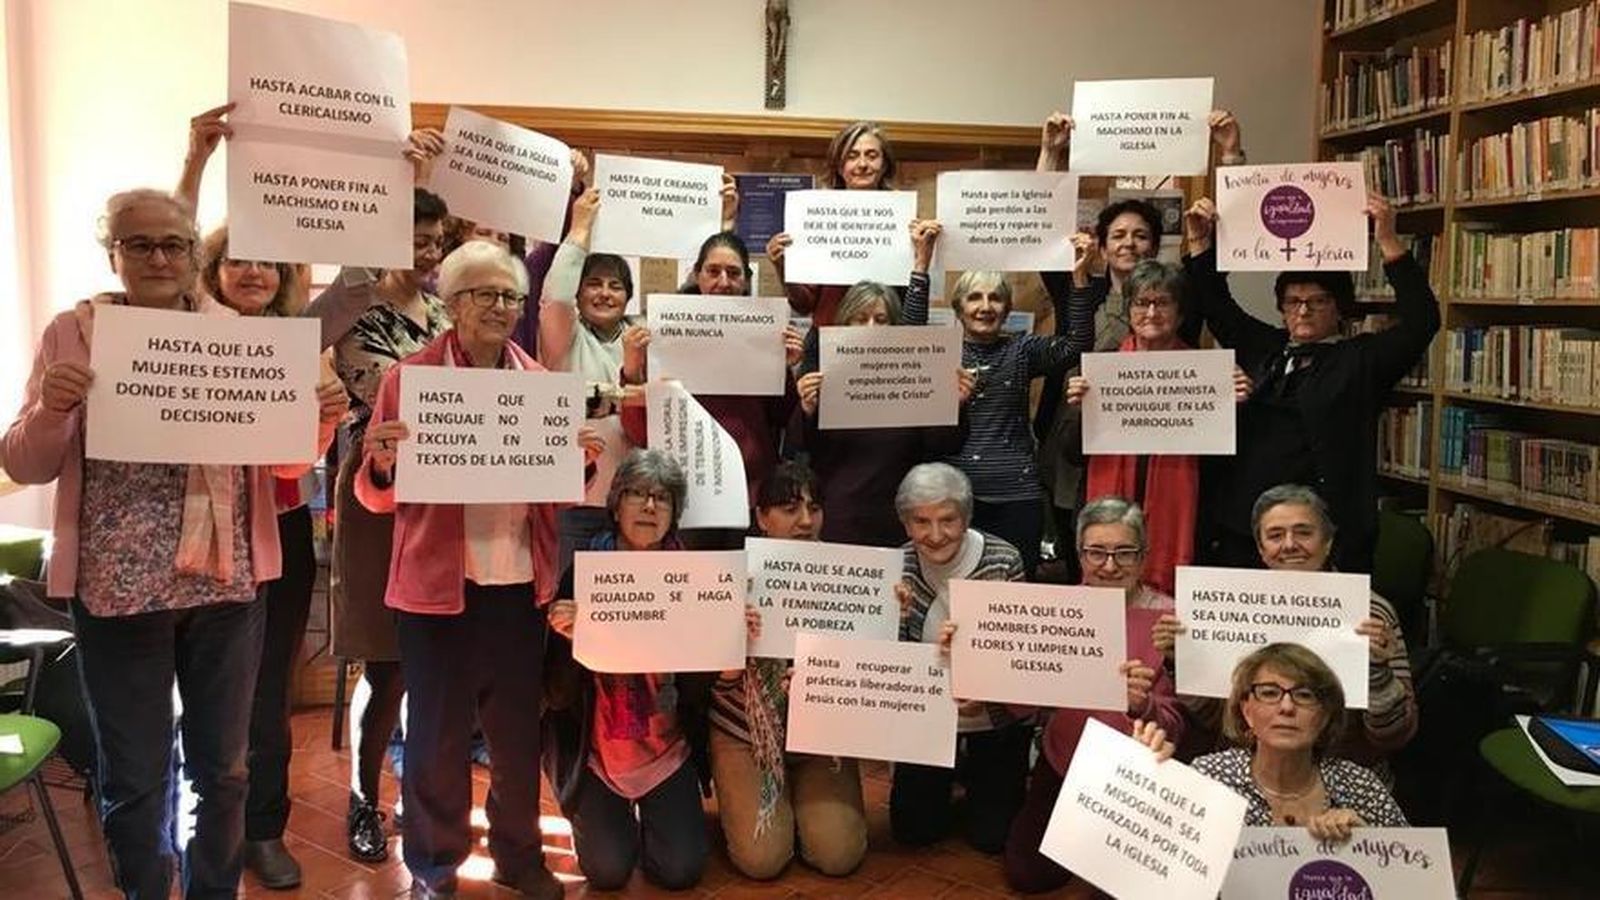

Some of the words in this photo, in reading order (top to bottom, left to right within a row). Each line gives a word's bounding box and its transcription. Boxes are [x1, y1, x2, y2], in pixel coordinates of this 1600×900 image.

[250, 77, 296, 94] HASTA
[298, 84, 351, 101] ACABAR
[353, 91, 380, 105] CON
[383, 95, 395, 107] EL
[278, 102, 372, 124] CLERICALISMO
[1090, 112, 1122, 121] HASTA
[1124, 112, 1157, 121] PONER
[1159, 112, 1176, 120] FIN
[1177, 111, 1191, 120] AL
[1119, 141, 1156, 150] IGLESIA
[455, 144, 473, 158] SEA
[475, 151, 499, 166] UNA
[500, 159, 557, 182] COMUNIDAD
[449, 159, 464, 171] DE
[464, 165, 508, 185] IGUALES
[253, 172, 298, 187] HASTA
[301, 176, 346, 191] PONER
[348, 181, 369, 193] FIN
[371, 184, 388, 195] AL
[609, 174, 640, 184] HASTA
[642, 176, 661, 187] QUE
[663, 179, 708, 191] CREAMOS
[263, 193, 339, 211] MACHISMO
[341, 200, 359, 212] EN
[362, 203, 378, 214] LA
[961, 190, 988, 199] Hasta
[990, 192, 1009, 201] que
[1010, 190, 1020, 198] la
[1022, 189, 1053, 200] Iglesia
[641, 206, 673, 217] NEGRA
[807, 207, 838, 215] HASTA
[839, 207, 858, 216] QUE
[861, 208, 871, 216] SE
[874, 207, 894, 217] NOS
[296, 216, 345, 230] IGLESIA
[830, 250, 868, 259] PECADO
[660, 312, 694, 321] HASTA
[694, 312, 716, 323] QUE
[719, 314, 775, 325] TENGAMOS
[660, 327, 683, 336] UNA
[684, 328, 724, 338] NUNCIA
[148, 337, 202, 354] HASTA
[207, 342, 242, 357] QUE
[246, 345, 274, 357] LAS
[836, 345, 865, 355] Hasta
[866, 346, 915, 354] reconocer
[917, 346, 930, 354] en
[932, 344, 945, 353] las
[132, 360, 208, 377] MUJERES
[212, 365, 285, 380] ESTEMOS
[1117, 370, 1155, 380] HASTA
[1156, 369, 1180, 380] QUE
[1182, 369, 1197, 379] LA
[116, 382, 176, 398] DONDE
[181, 386, 199, 399] SE
[204, 387, 266, 402] TOMAN
[270, 389, 296, 402] LAS
[419, 391, 464, 404] HASTA
[497, 393, 524, 407] QUE
[557, 396, 570, 407] EL
[1100, 384, 1154, 397] TEOLOGÍA
[1156, 385, 1216, 395] FEMINISTA
[1101, 402, 1113, 411] SE
[1115, 402, 1171, 412] DIVULGUE
[1177, 401, 1192, 411] EN
[1194, 401, 1215, 411] LAS
[160, 408, 255, 424] DECISIONES
[418, 412, 485, 425] LENGUAJE
[498, 414, 519, 426] NO
[543, 415, 570, 427] NOS
[1121, 417, 1194, 429] PARROQUIAS
[417, 432, 477, 445] EXCLUYA
[503, 434, 520, 445] EN
[545, 435, 568, 446] LOS
[416, 453, 467, 465] TEXTOS
[470, 454, 486, 465] DE
[490, 454, 506, 465] LA
[508, 454, 555, 466] IGLESIA
[594, 573, 635, 584] HASTA
[663, 572, 689, 584] QUE
[718, 573, 733, 583] LA
[763, 560, 802, 573] HASTA
[804, 563, 829, 575] QUE
[831, 565, 844, 576] SE
[846, 566, 885, 579] ACABE
[764, 578, 791, 590] CON
[793, 580, 808, 591] LA
[810, 581, 870, 596] VIOLENCIA
[872, 587, 880, 596] Y
[590, 591, 655, 604] IGUALDAD
[669, 590, 683, 602] SE
[697, 590, 732, 601] HAGA
[758, 596, 773, 607] LA
[868, 604, 883, 615] DE
[1192, 590, 1235, 603] HASTA
[1238, 592, 1267, 605] QUE
[1270, 594, 1287, 605] LA
[1290, 595, 1342, 609] IGLESIA
[590, 609, 667, 622] COSTUMBRE
[988, 603, 1028, 615] HASTA
[1030, 605, 1057, 617] QUE
[1060, 608, 1084, 620] LOS
[1192, 609, 1216, 621] SEA
[1219, 611, 1249, 623] UNA
[1252, 612, 1341, 628] COMUNIDAD
[785, 615, 799, 627] LA
[801, 617, 855, 631] POBREZA
[978, 620, 1038, 635] HOMBRES
[1040, 624, 1095, 638] PONGAN
[1192, 627, 1209, 640] DE
[1212, 630, 1267, 644] IGUALES
[971, 638, 1014, 651] FLORES
[1016, 641, 1025, 651] Y
[1027, 642, 1078, 655] LIMPIEN
[1081, 646, 1104, 657] LAS
[806, 656, 840, 668] Hasta
[855, 662, 912, 675] recuperar
[928, 666, 944, 677] las
[1010, 658, 1063, 673] IGLESIAS
[805, 675, 857, 687] prácticas
[859, 677, 925, 694] liberadoras
[927, 684, 943, 695] de
[836, 696, 858, 706] con
[860, 696, 877, 707] las
[879, 700, 926, 712] mujeres
[1116, 765, 1156, 794] HASTA
[1159, 787, 1187, 810] QUE
[1189, 802, 1206, 818] LA
[1104, 783, 1173, 829] MISOGINIA
[1178, 822, 1200, 843] SEA
[1077, 792, 1149, 841] RECHAZADA
[1151, 833, 1179, 856] POR
[1180, 849, 1208, 877] TODA
[1105, 833, 1121, 852] LA
[1123, 843, 1168, 878] IGLESIA
[1352, 837, 1432, 869] mujeres
